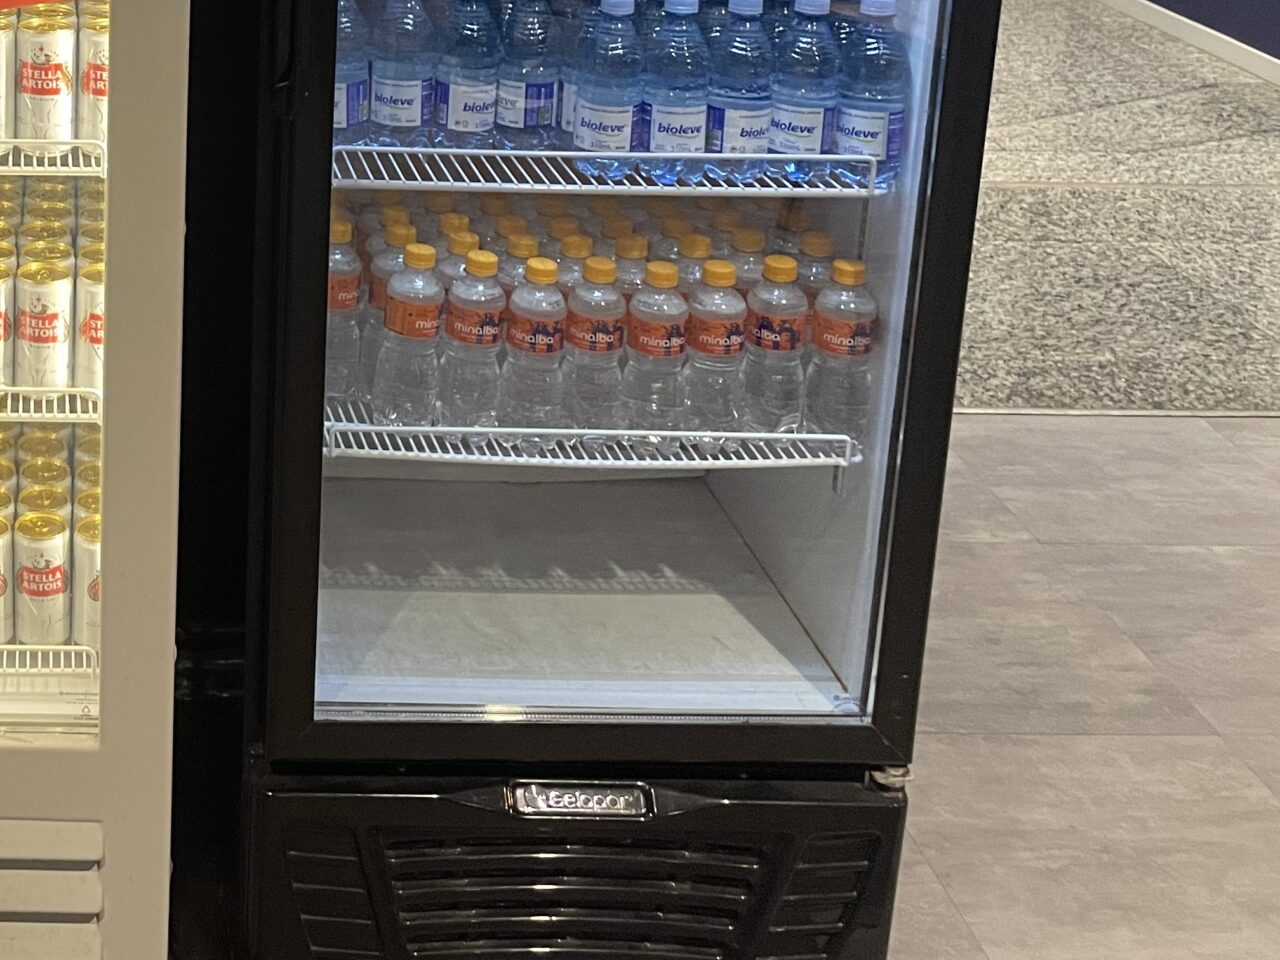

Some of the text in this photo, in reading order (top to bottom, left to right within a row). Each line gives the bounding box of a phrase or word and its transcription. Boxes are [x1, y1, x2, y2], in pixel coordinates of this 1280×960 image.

[23, 69, 63, 79] STELLA
[90, 70, 108, 80] STE
[22, 79, 63, 89] ARTOIS
[90, 80, 108, 89] ART
[374, 93, 414, 106] bioleve
[463, 102, 496, 114] biole
[580, 117, 624, 133] bioleve
[657, 123, 702, 135] bioleve
[771, 118, 815, 134] bioleve
[836, 125, 880, 139] bioleve
[20, 316, 59, 327] STELLA
[20, 326, 60, 337] ARTOIS
[510, 329, 554, 345] minalba
[571, 327, 614, 343] minalba
[754, 328, 781, 342] alba
[823, 332, 871, 347] minalba
[22, 572, 61, 583] STELLA
[22, 581, 62, 591] ARTOIS
